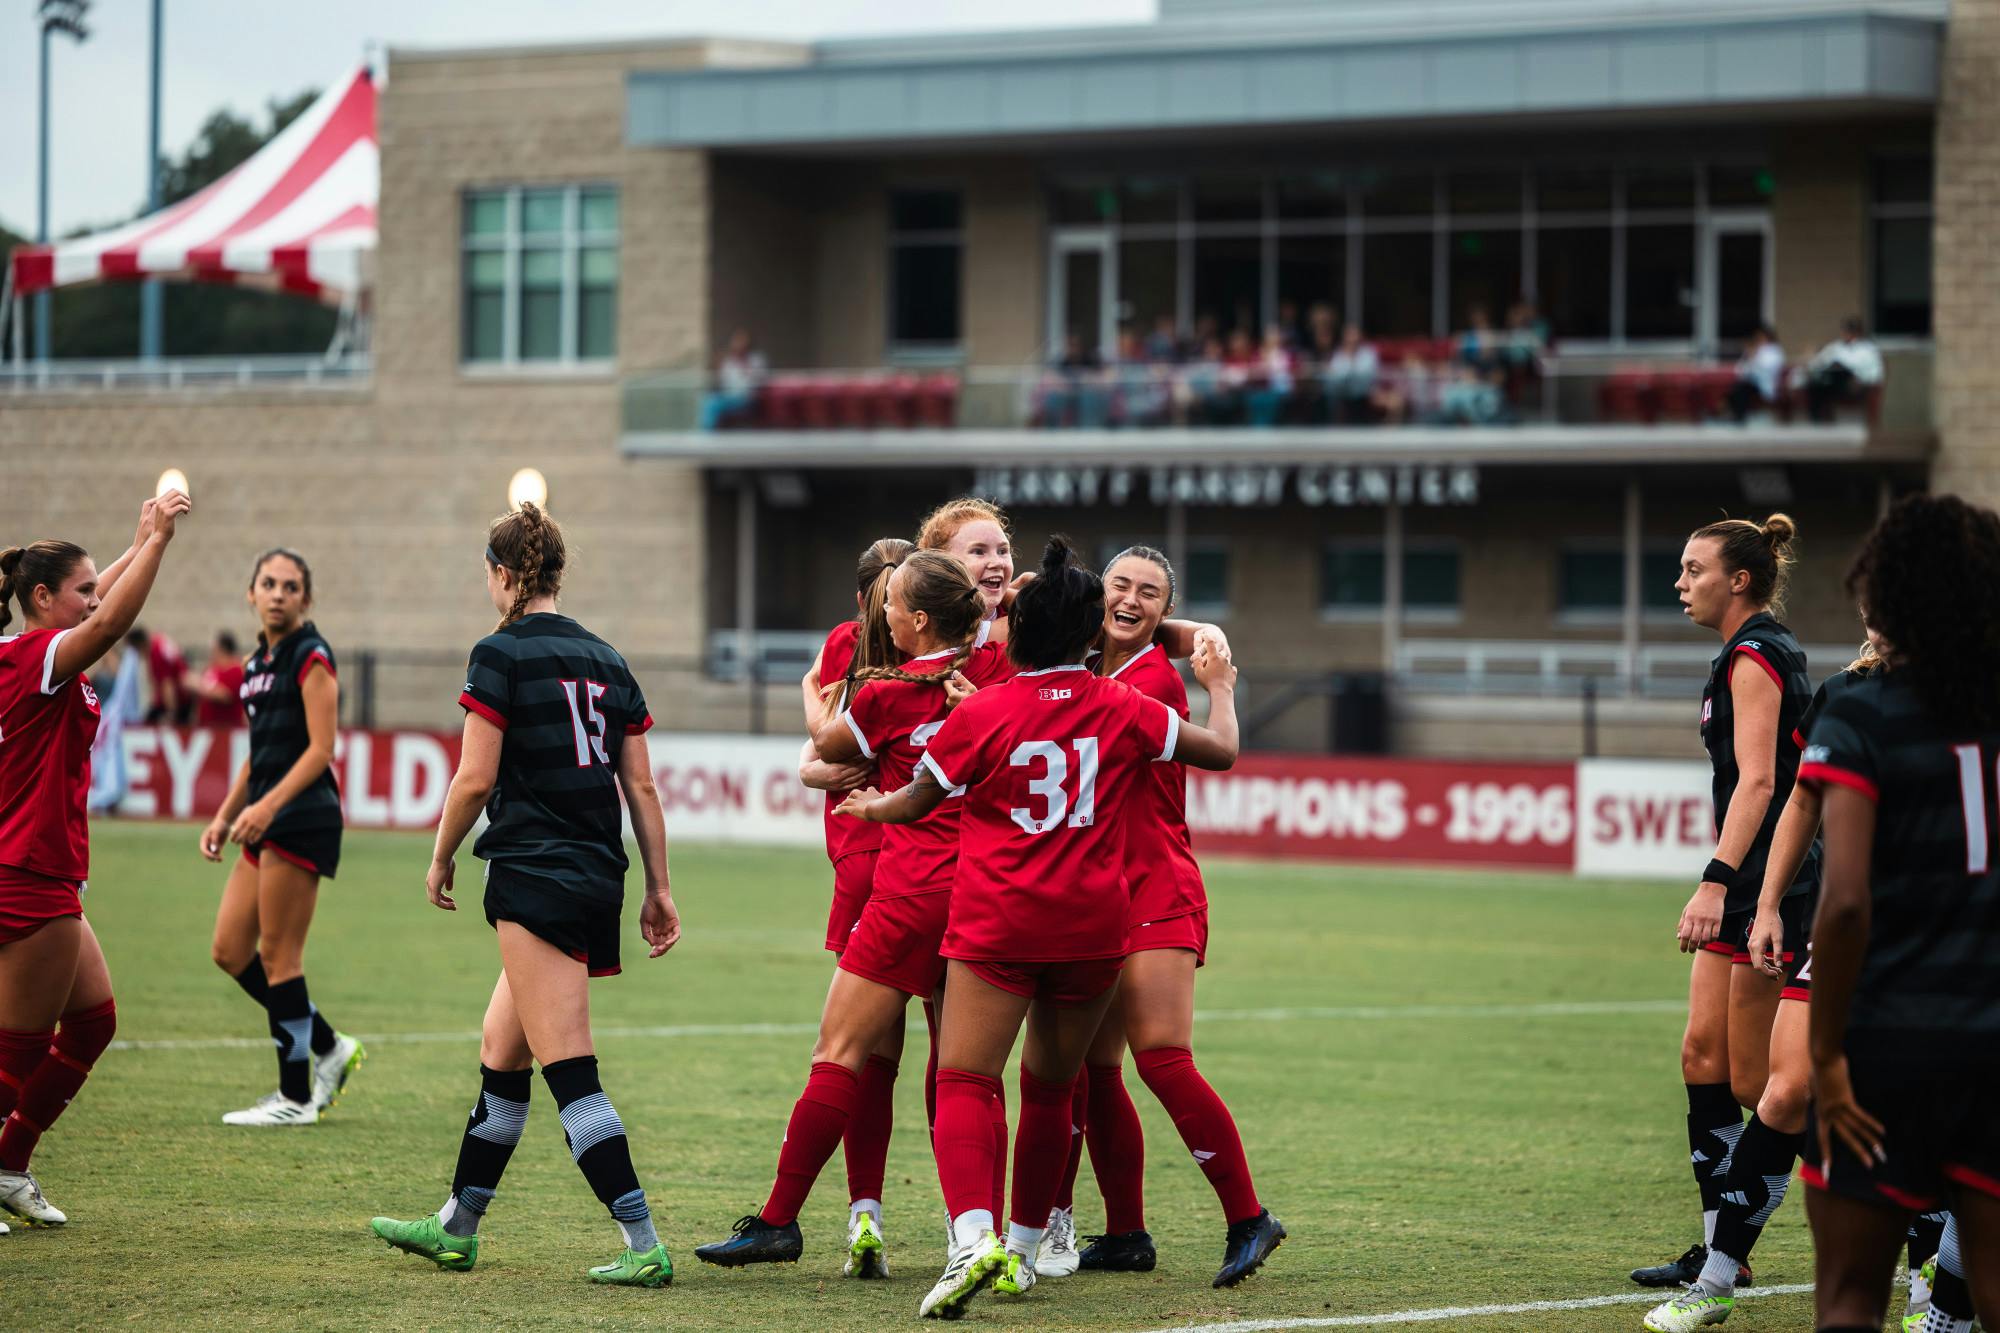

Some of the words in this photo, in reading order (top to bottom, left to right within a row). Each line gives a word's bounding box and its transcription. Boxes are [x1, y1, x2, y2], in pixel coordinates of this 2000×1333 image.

[1299, 466, 1479, 506] CENTER
[559, 679, 610, 768] 15
[1009, 736, 1099, 834] 31
[1445, 783, 1571, 844] 1996
[1593, 795, 1718, 848] SWE
[1950, 743, 2000, 875] 1
